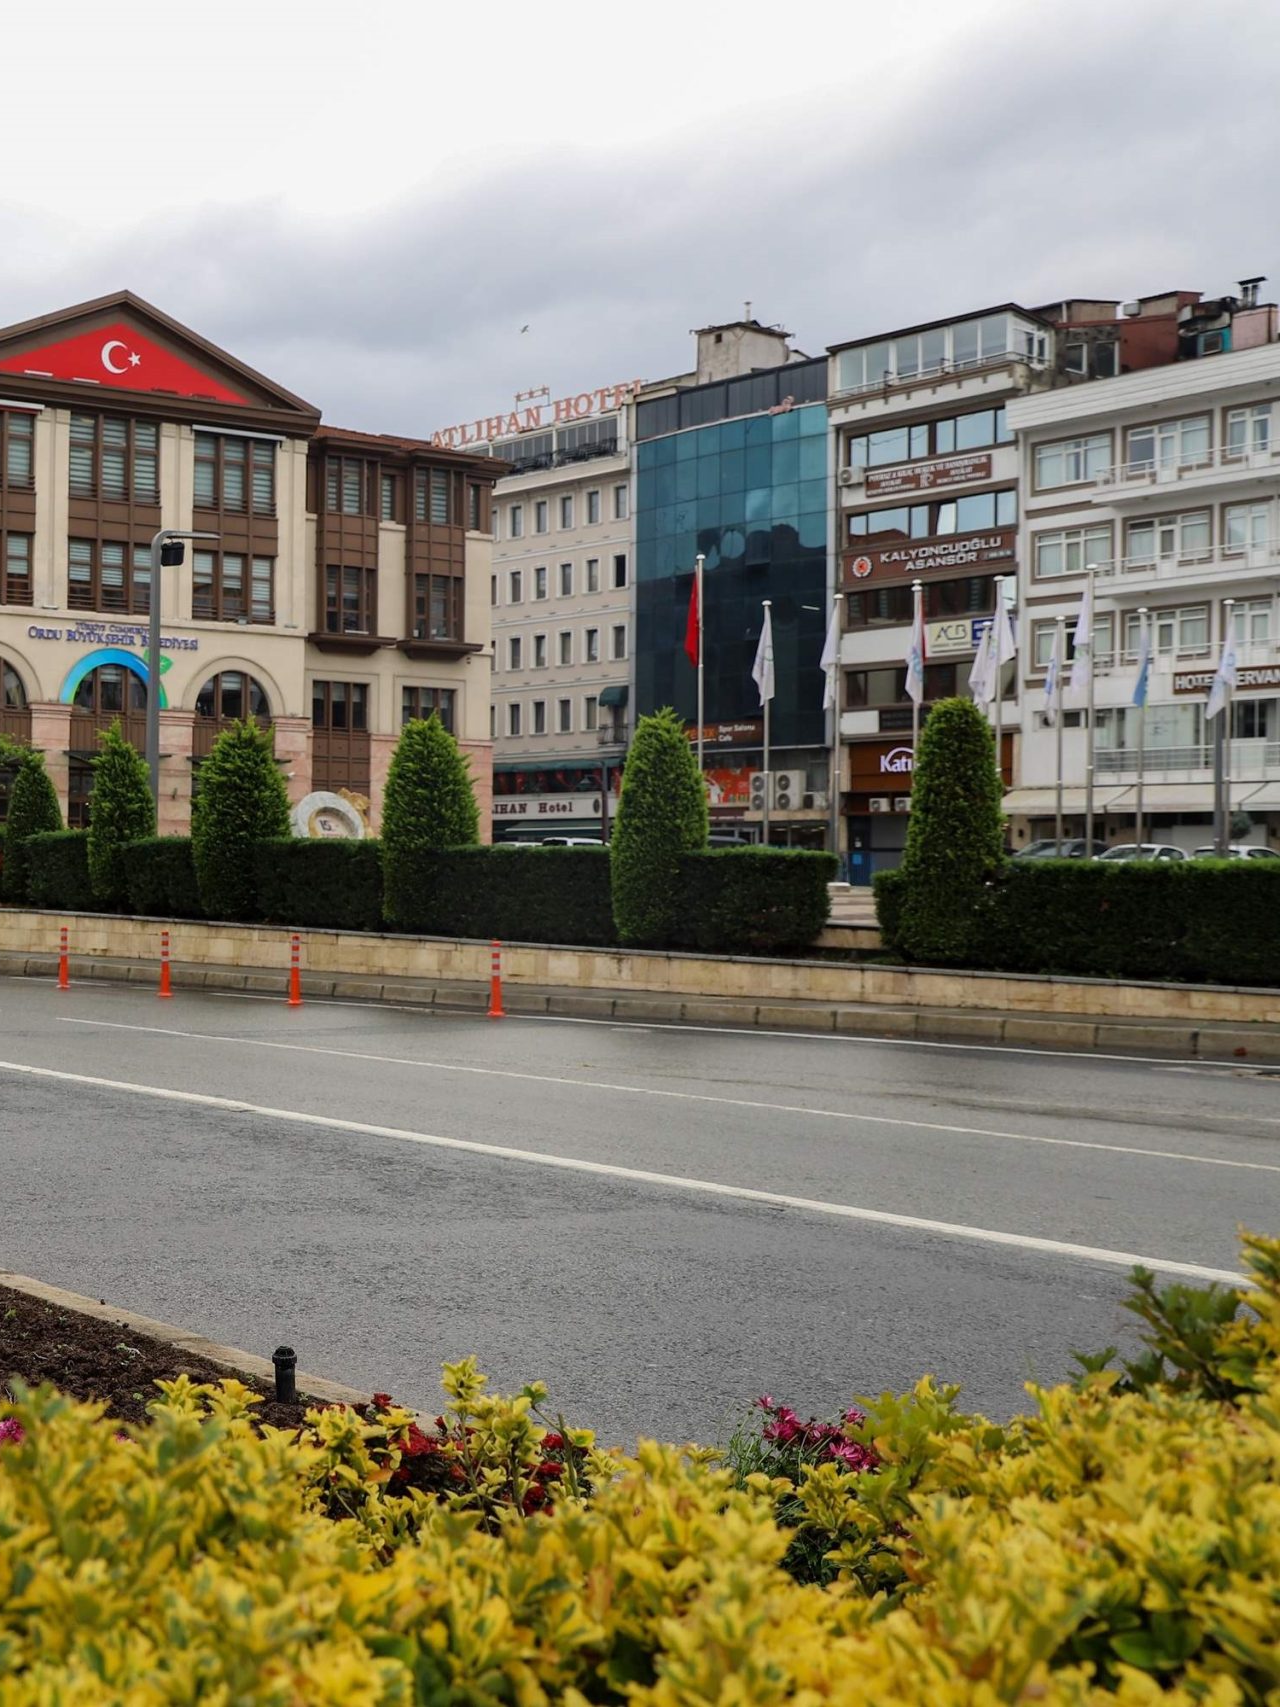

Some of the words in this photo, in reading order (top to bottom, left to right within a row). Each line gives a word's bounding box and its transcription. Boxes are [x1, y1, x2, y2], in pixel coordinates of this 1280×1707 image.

[431, 404, 542, 449] ATLIHAN
[880, 536, 1001, 563] KALYONCUOĞLU
[904, 551, 977, 571] ASANSÖR
[28, 626, 62, 640] ORDU
[141, 635, 198, 650] BEDİYESİ
[1175, 673, 1216, 689] HOTE
[492, 803, 528, 814] IHAN
[538, 802, 573, 813] Hotel
